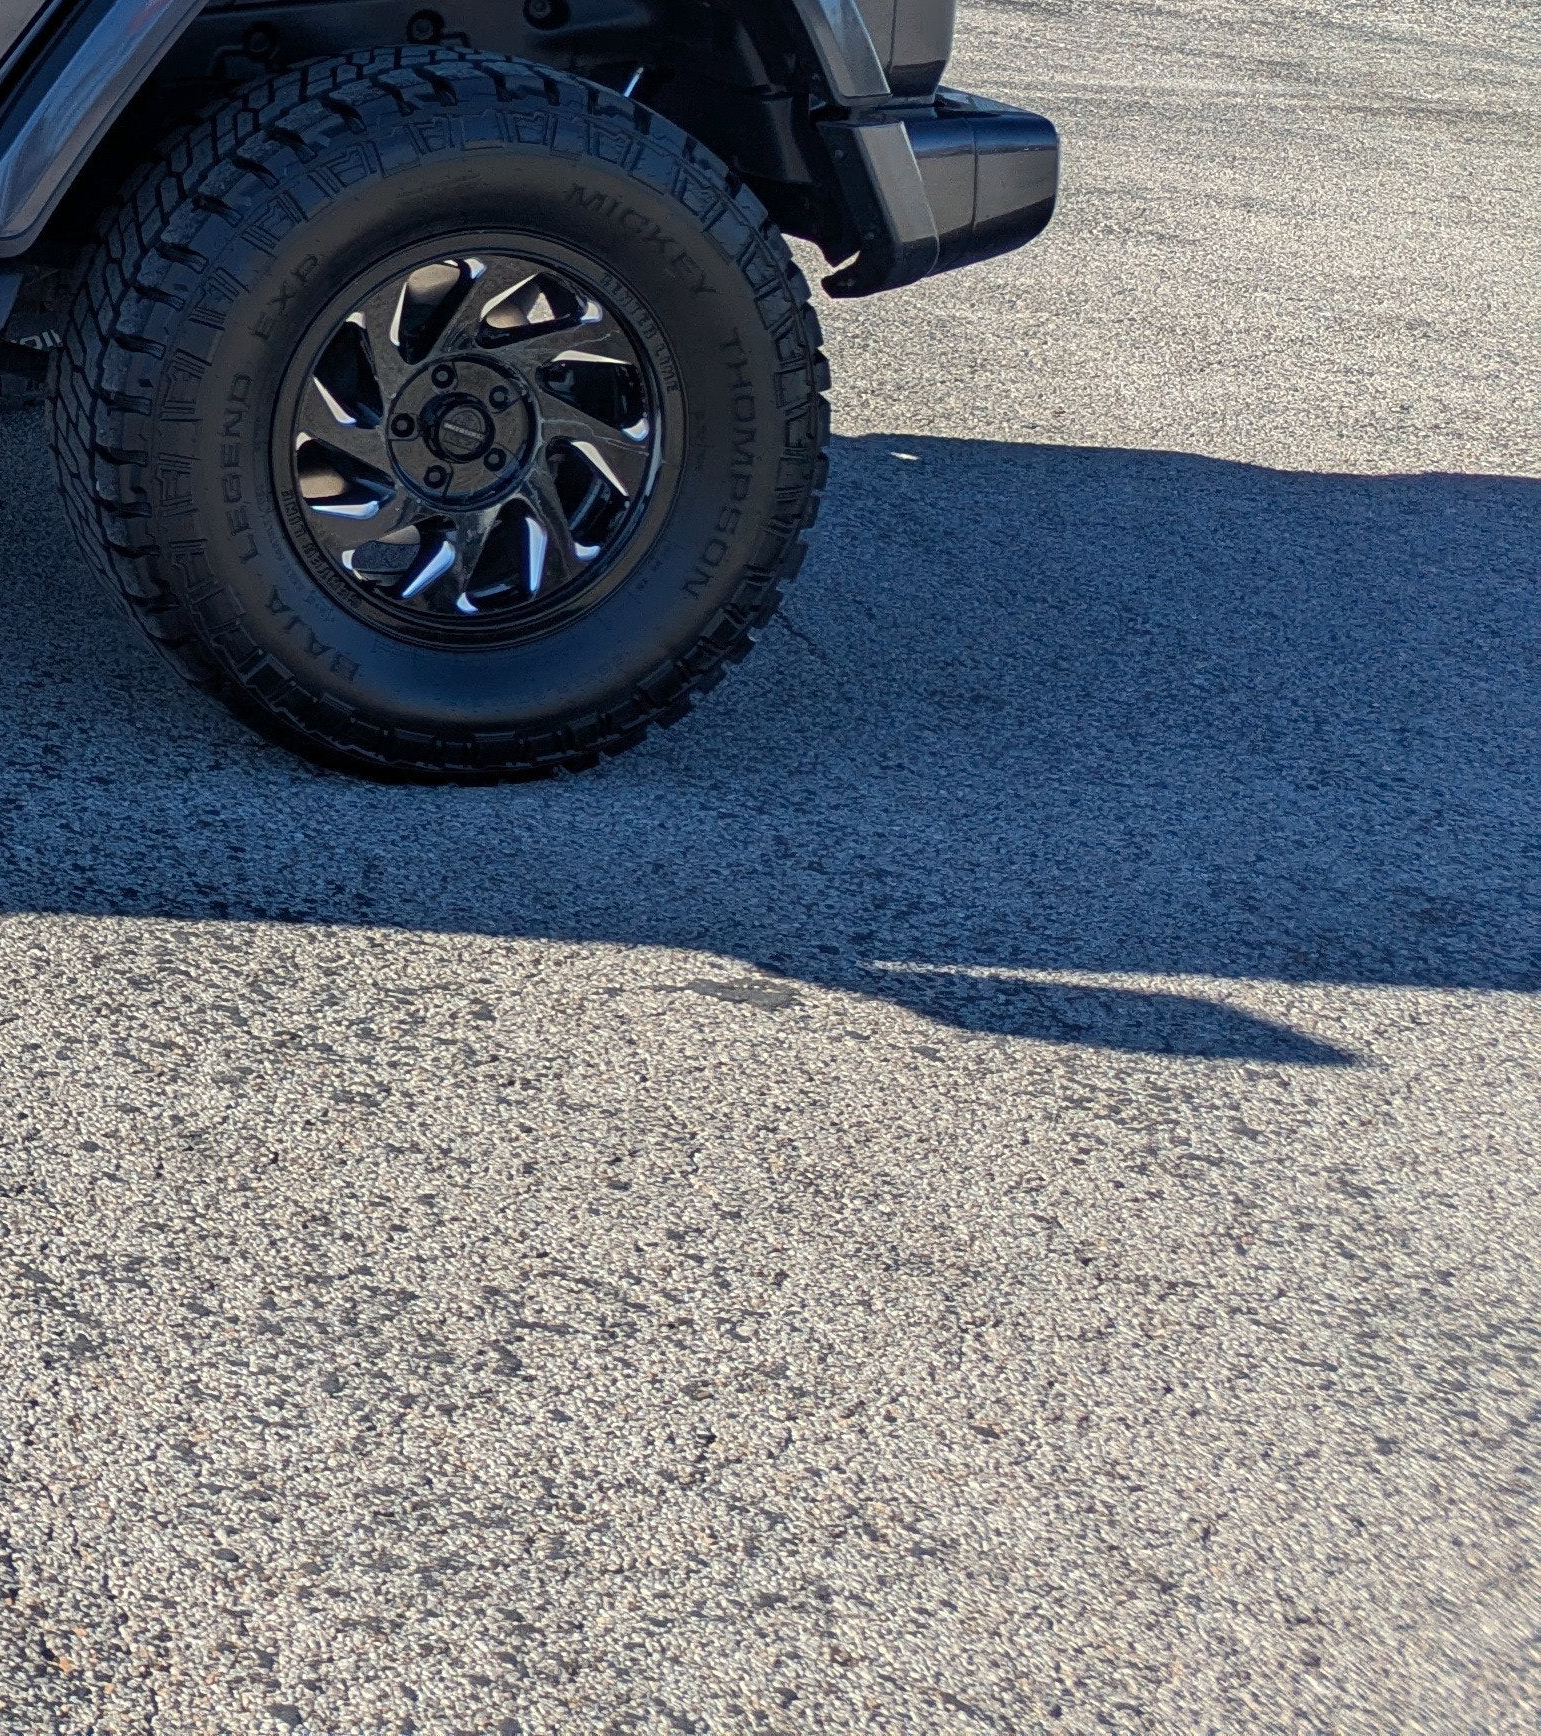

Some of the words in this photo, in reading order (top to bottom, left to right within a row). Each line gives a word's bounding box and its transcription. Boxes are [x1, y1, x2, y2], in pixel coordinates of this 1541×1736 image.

[219, 372, 258, 564] LEGEND
[567, 183, 718, 298] MICKEY
[682, 326, 757, 600] THOMPSON
[266, 585, 360, 681] BAJA
